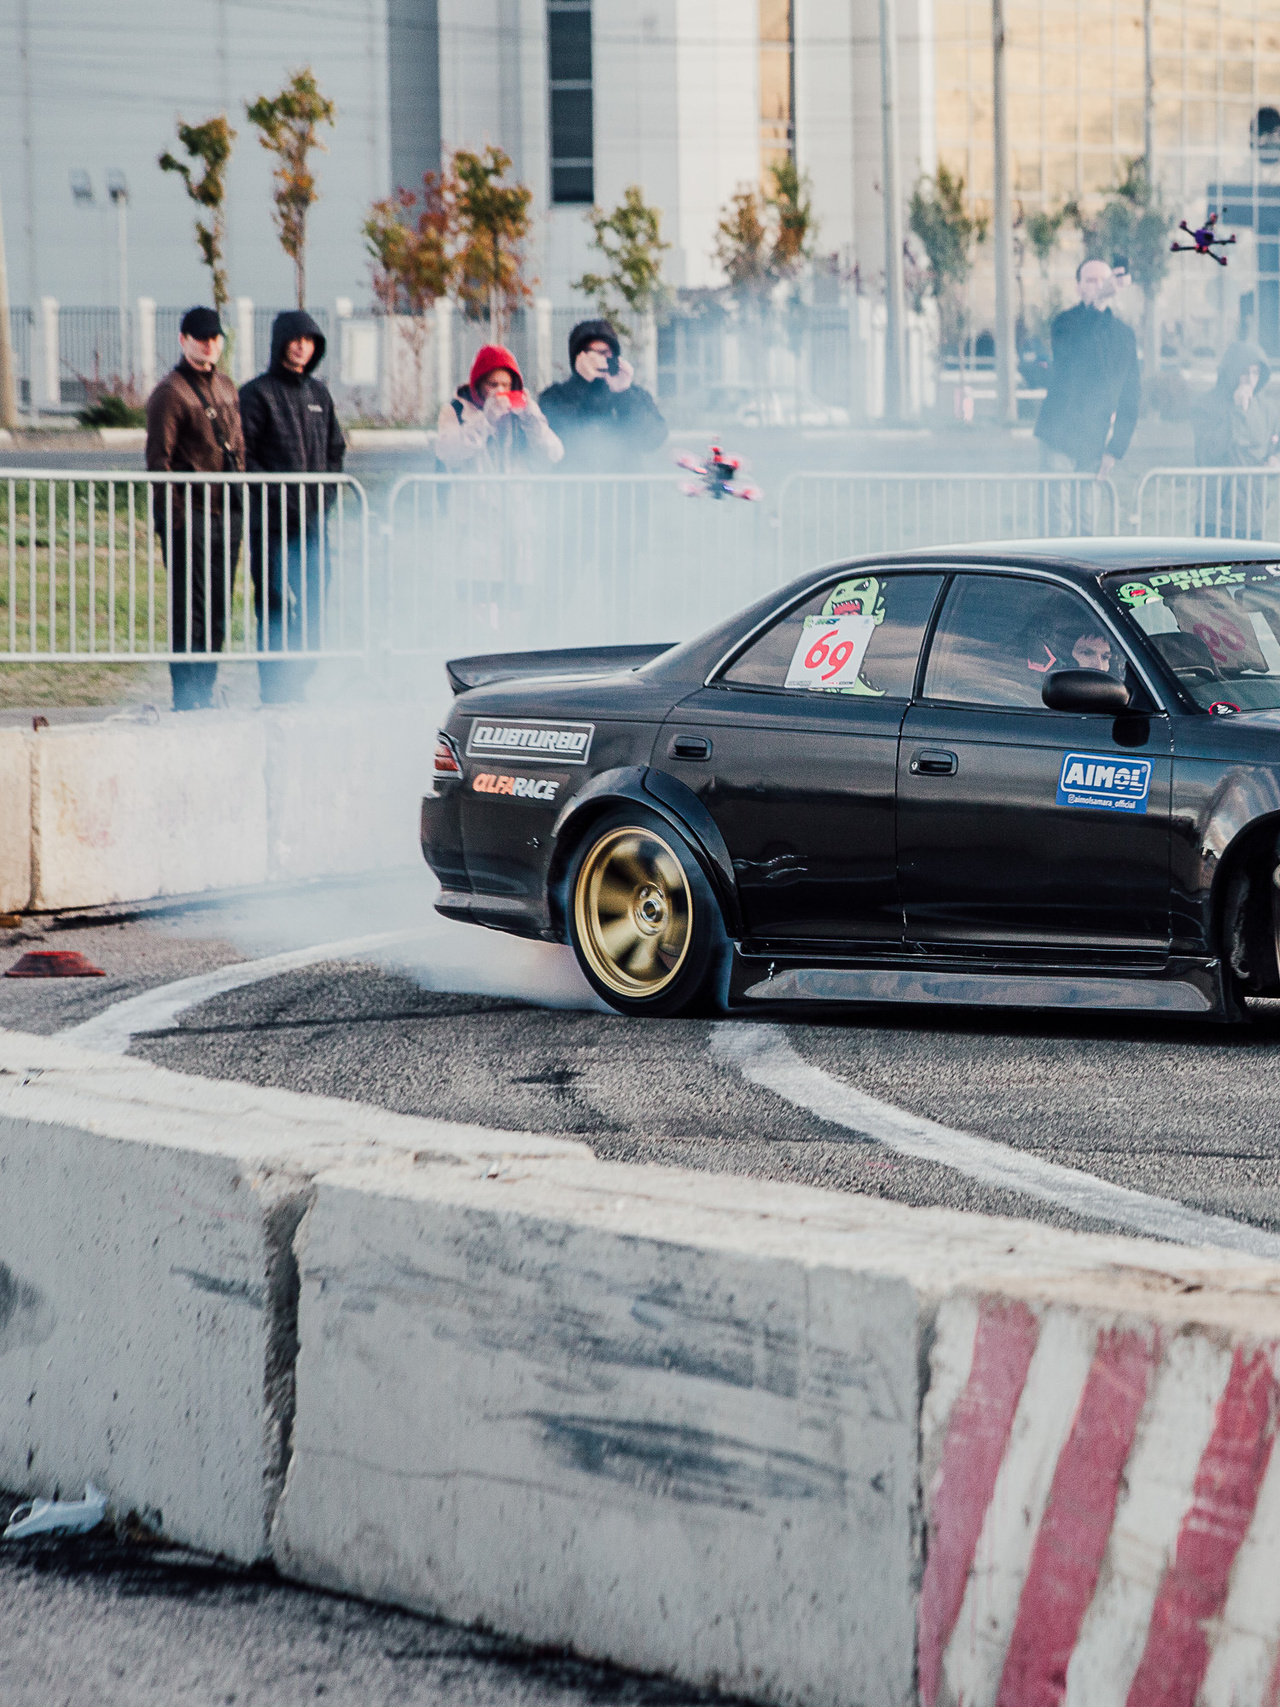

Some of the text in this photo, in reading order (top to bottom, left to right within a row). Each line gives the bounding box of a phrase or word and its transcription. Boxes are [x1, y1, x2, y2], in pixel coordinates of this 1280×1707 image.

[1149, 565, 1233, 588] DRIFT
[1173, 572, 1247, 592] THAT
[804, 629, 855, 682] 69
[472, 726, 589, 752] CLUBTURBO
